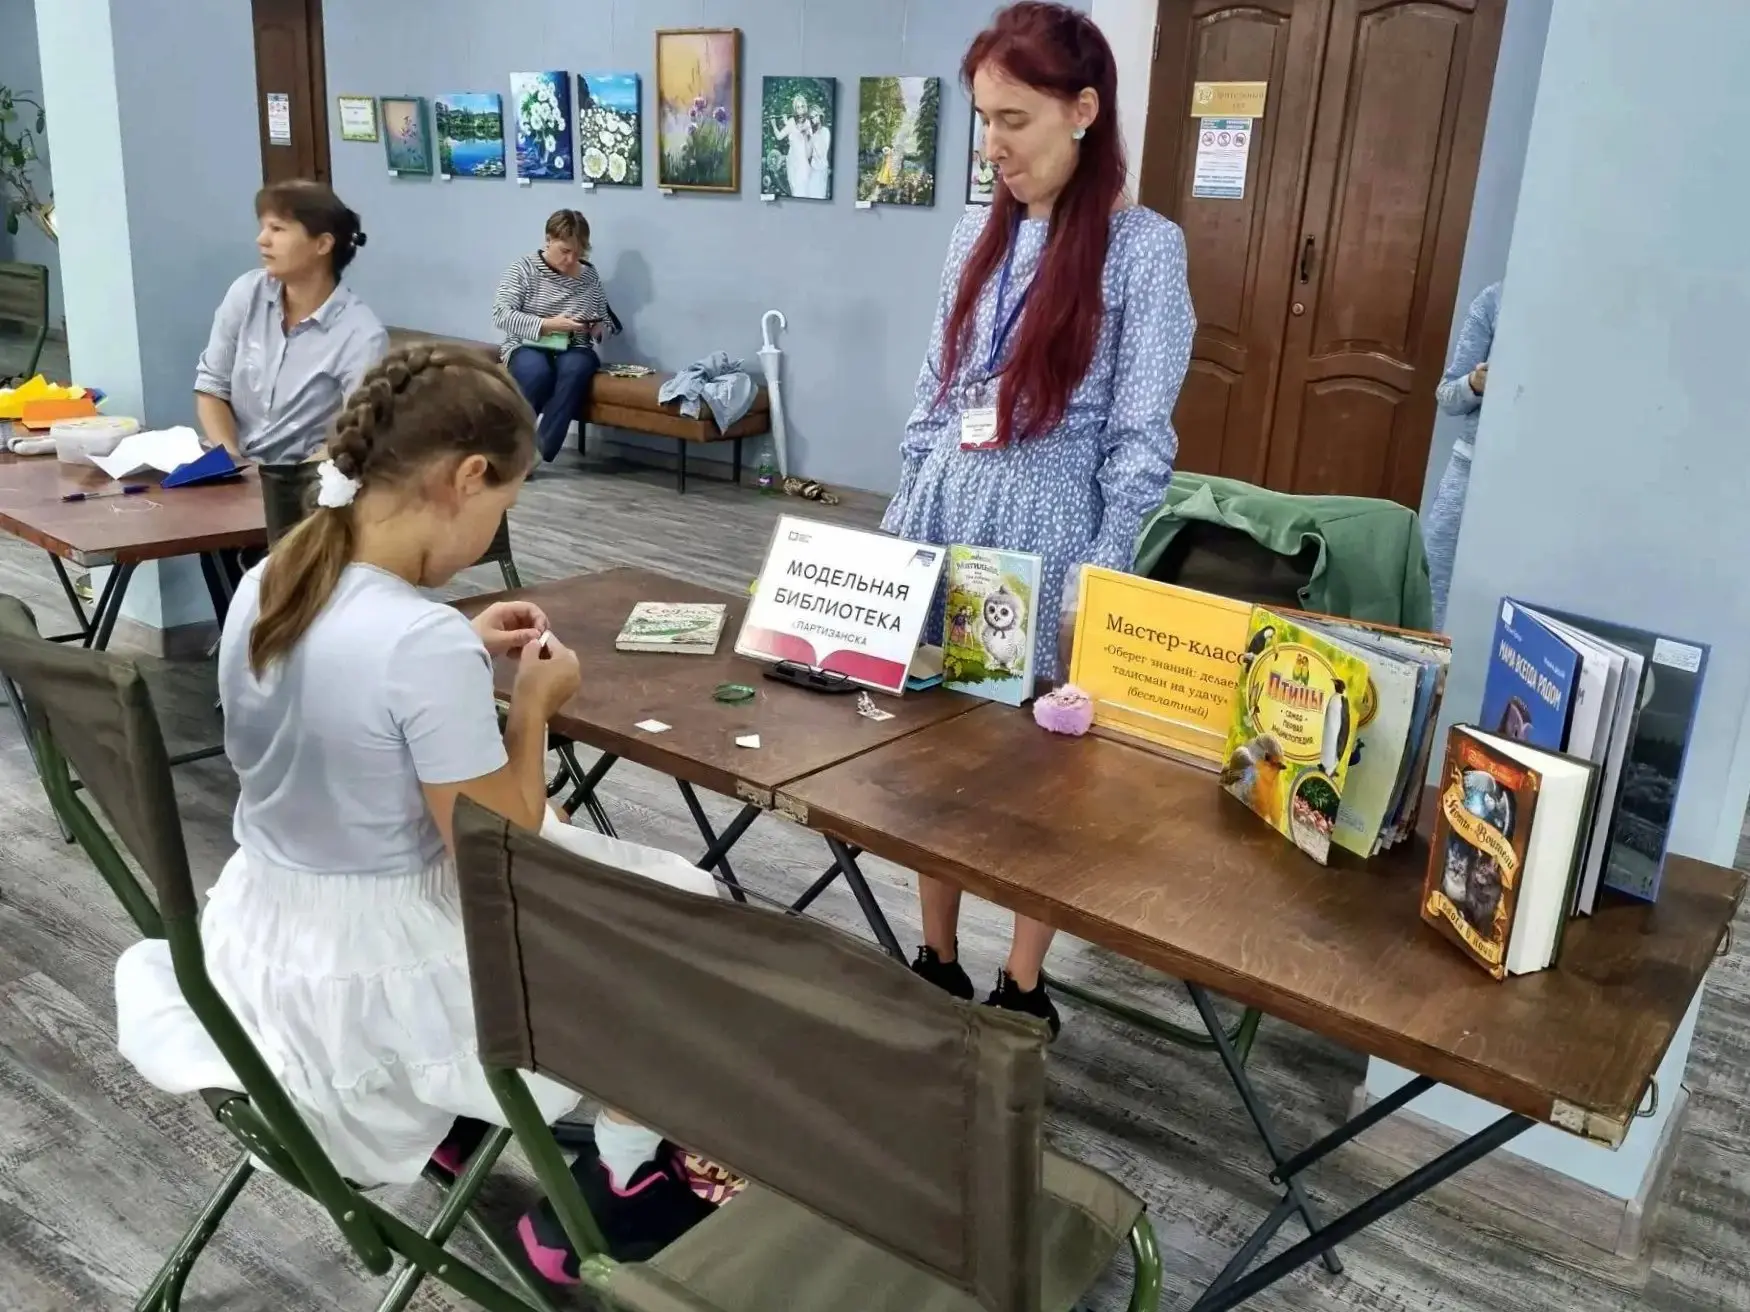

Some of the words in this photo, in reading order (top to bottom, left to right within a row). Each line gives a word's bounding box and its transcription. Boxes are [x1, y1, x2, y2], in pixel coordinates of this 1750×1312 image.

[786, 560, 910, 601] МОДЕЛЬНАЯ
[773, 587, 901, 632] БИБЛИОТЕКА
[1112, 665, 1168, 688] талисман
[1170, 681, 1185, 693] на
[1537, 674, 1562, 712] РЯДОМ
[1127, 686, 1209, 720] (бесплатный)
